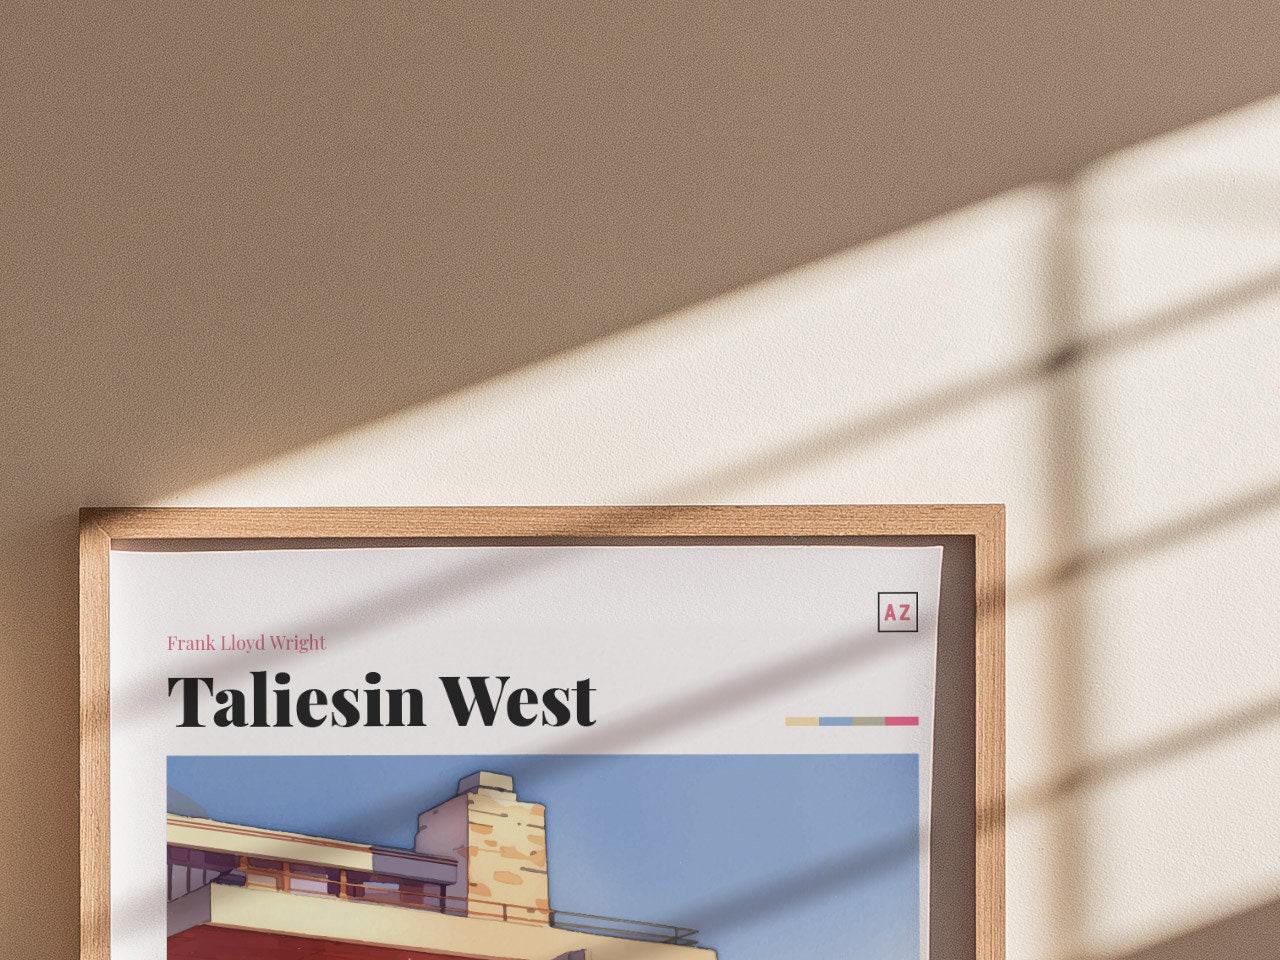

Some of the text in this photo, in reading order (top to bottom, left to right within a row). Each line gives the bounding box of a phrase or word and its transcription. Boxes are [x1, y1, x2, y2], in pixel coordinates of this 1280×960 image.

[884, 603, 911, 621] AZ
[167, 634, 327, 653] Frank Lloyd Wright
[168, 671, 596, 727] Taliesin West
